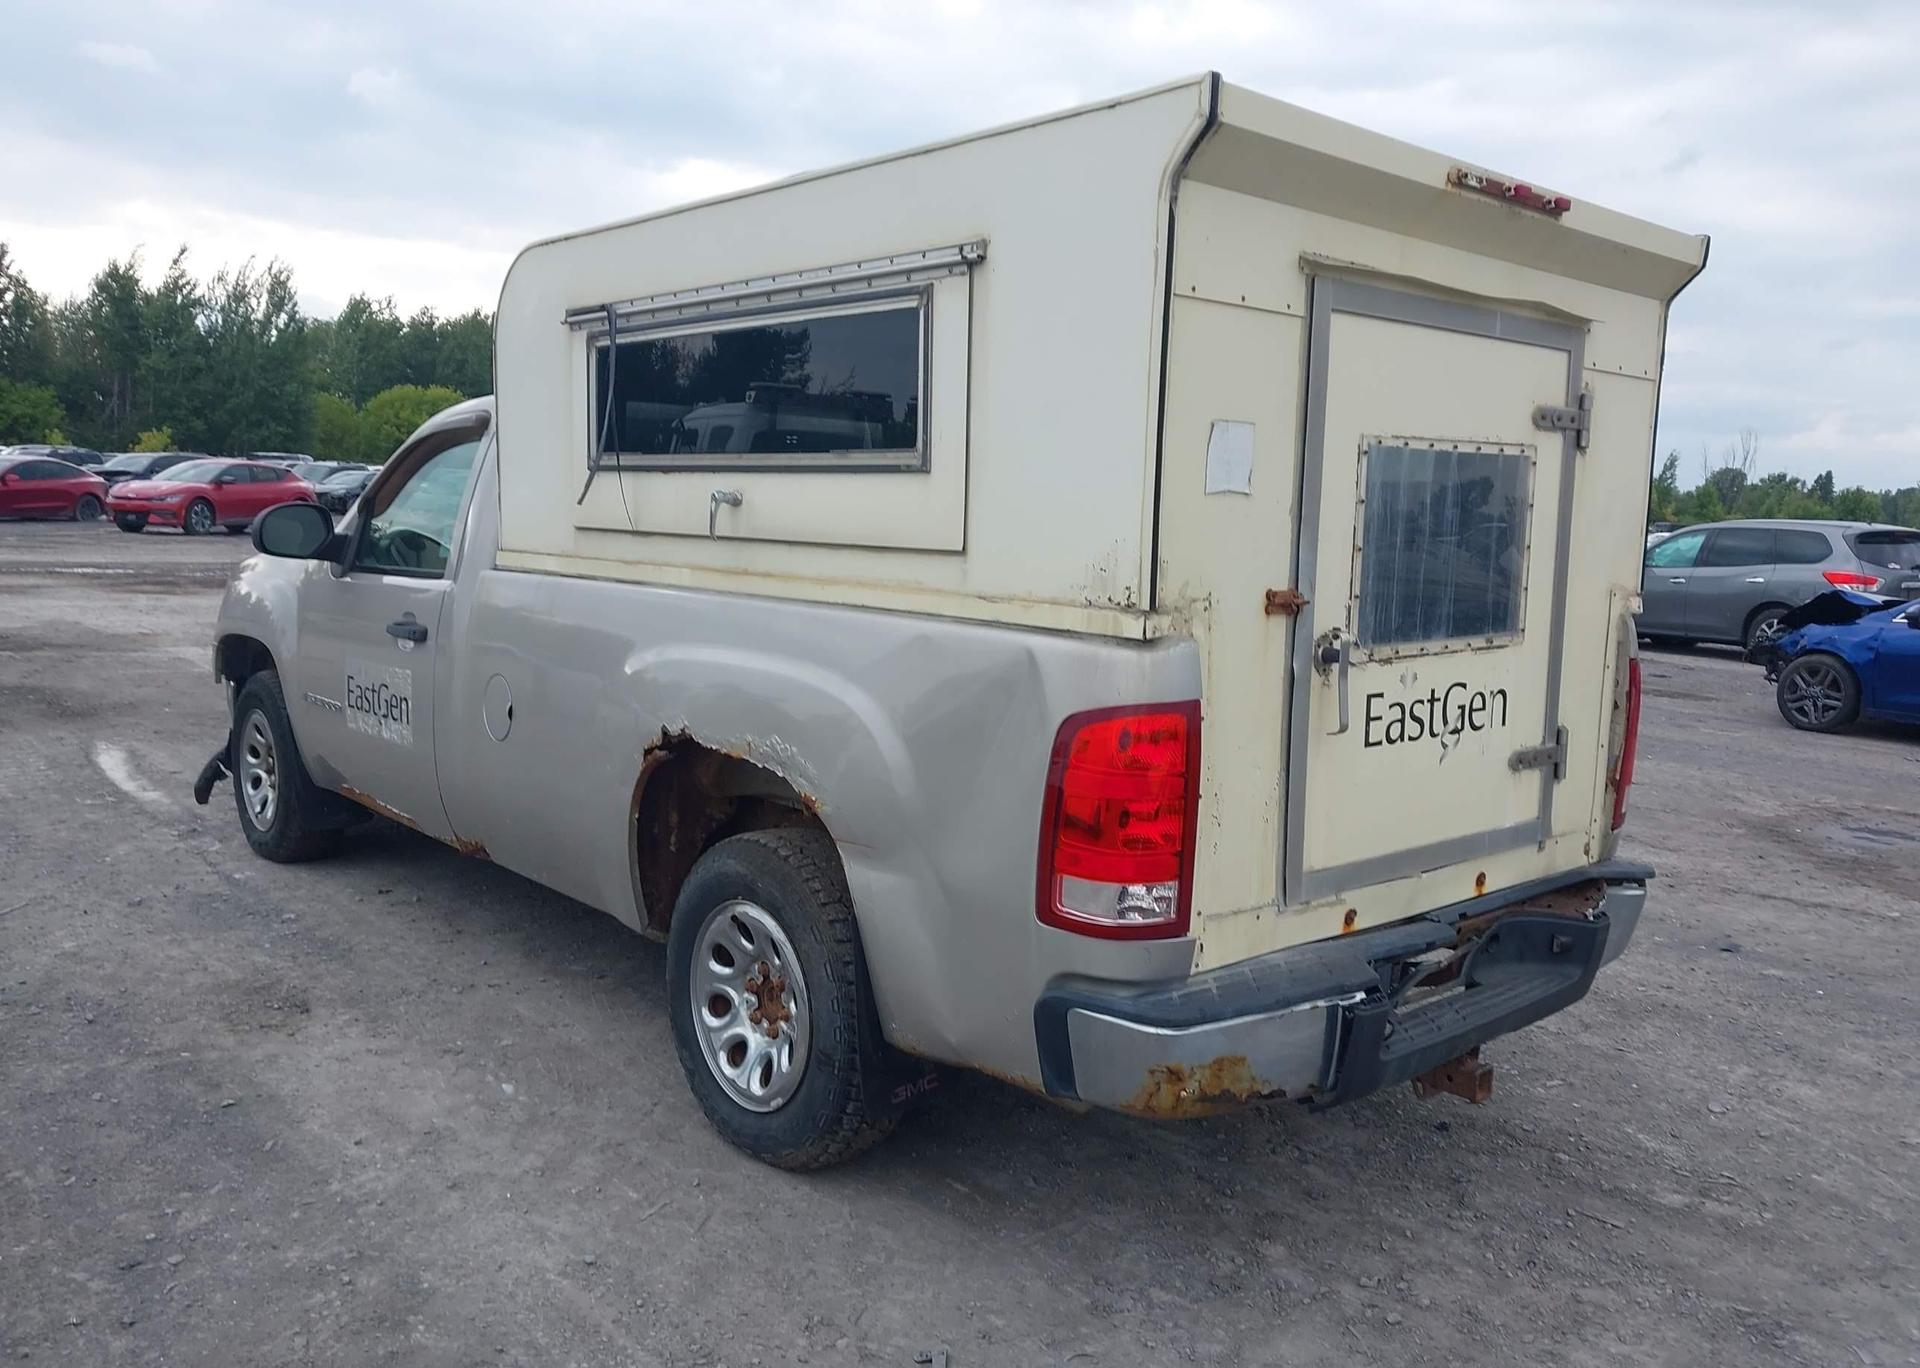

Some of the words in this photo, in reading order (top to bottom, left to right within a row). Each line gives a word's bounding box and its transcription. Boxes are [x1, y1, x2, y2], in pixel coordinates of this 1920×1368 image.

[347, 675, 410, 725] EastGen
[1364, 682, 1508, 748] EastGen
[891, 1073, 939, 1104] GMC
